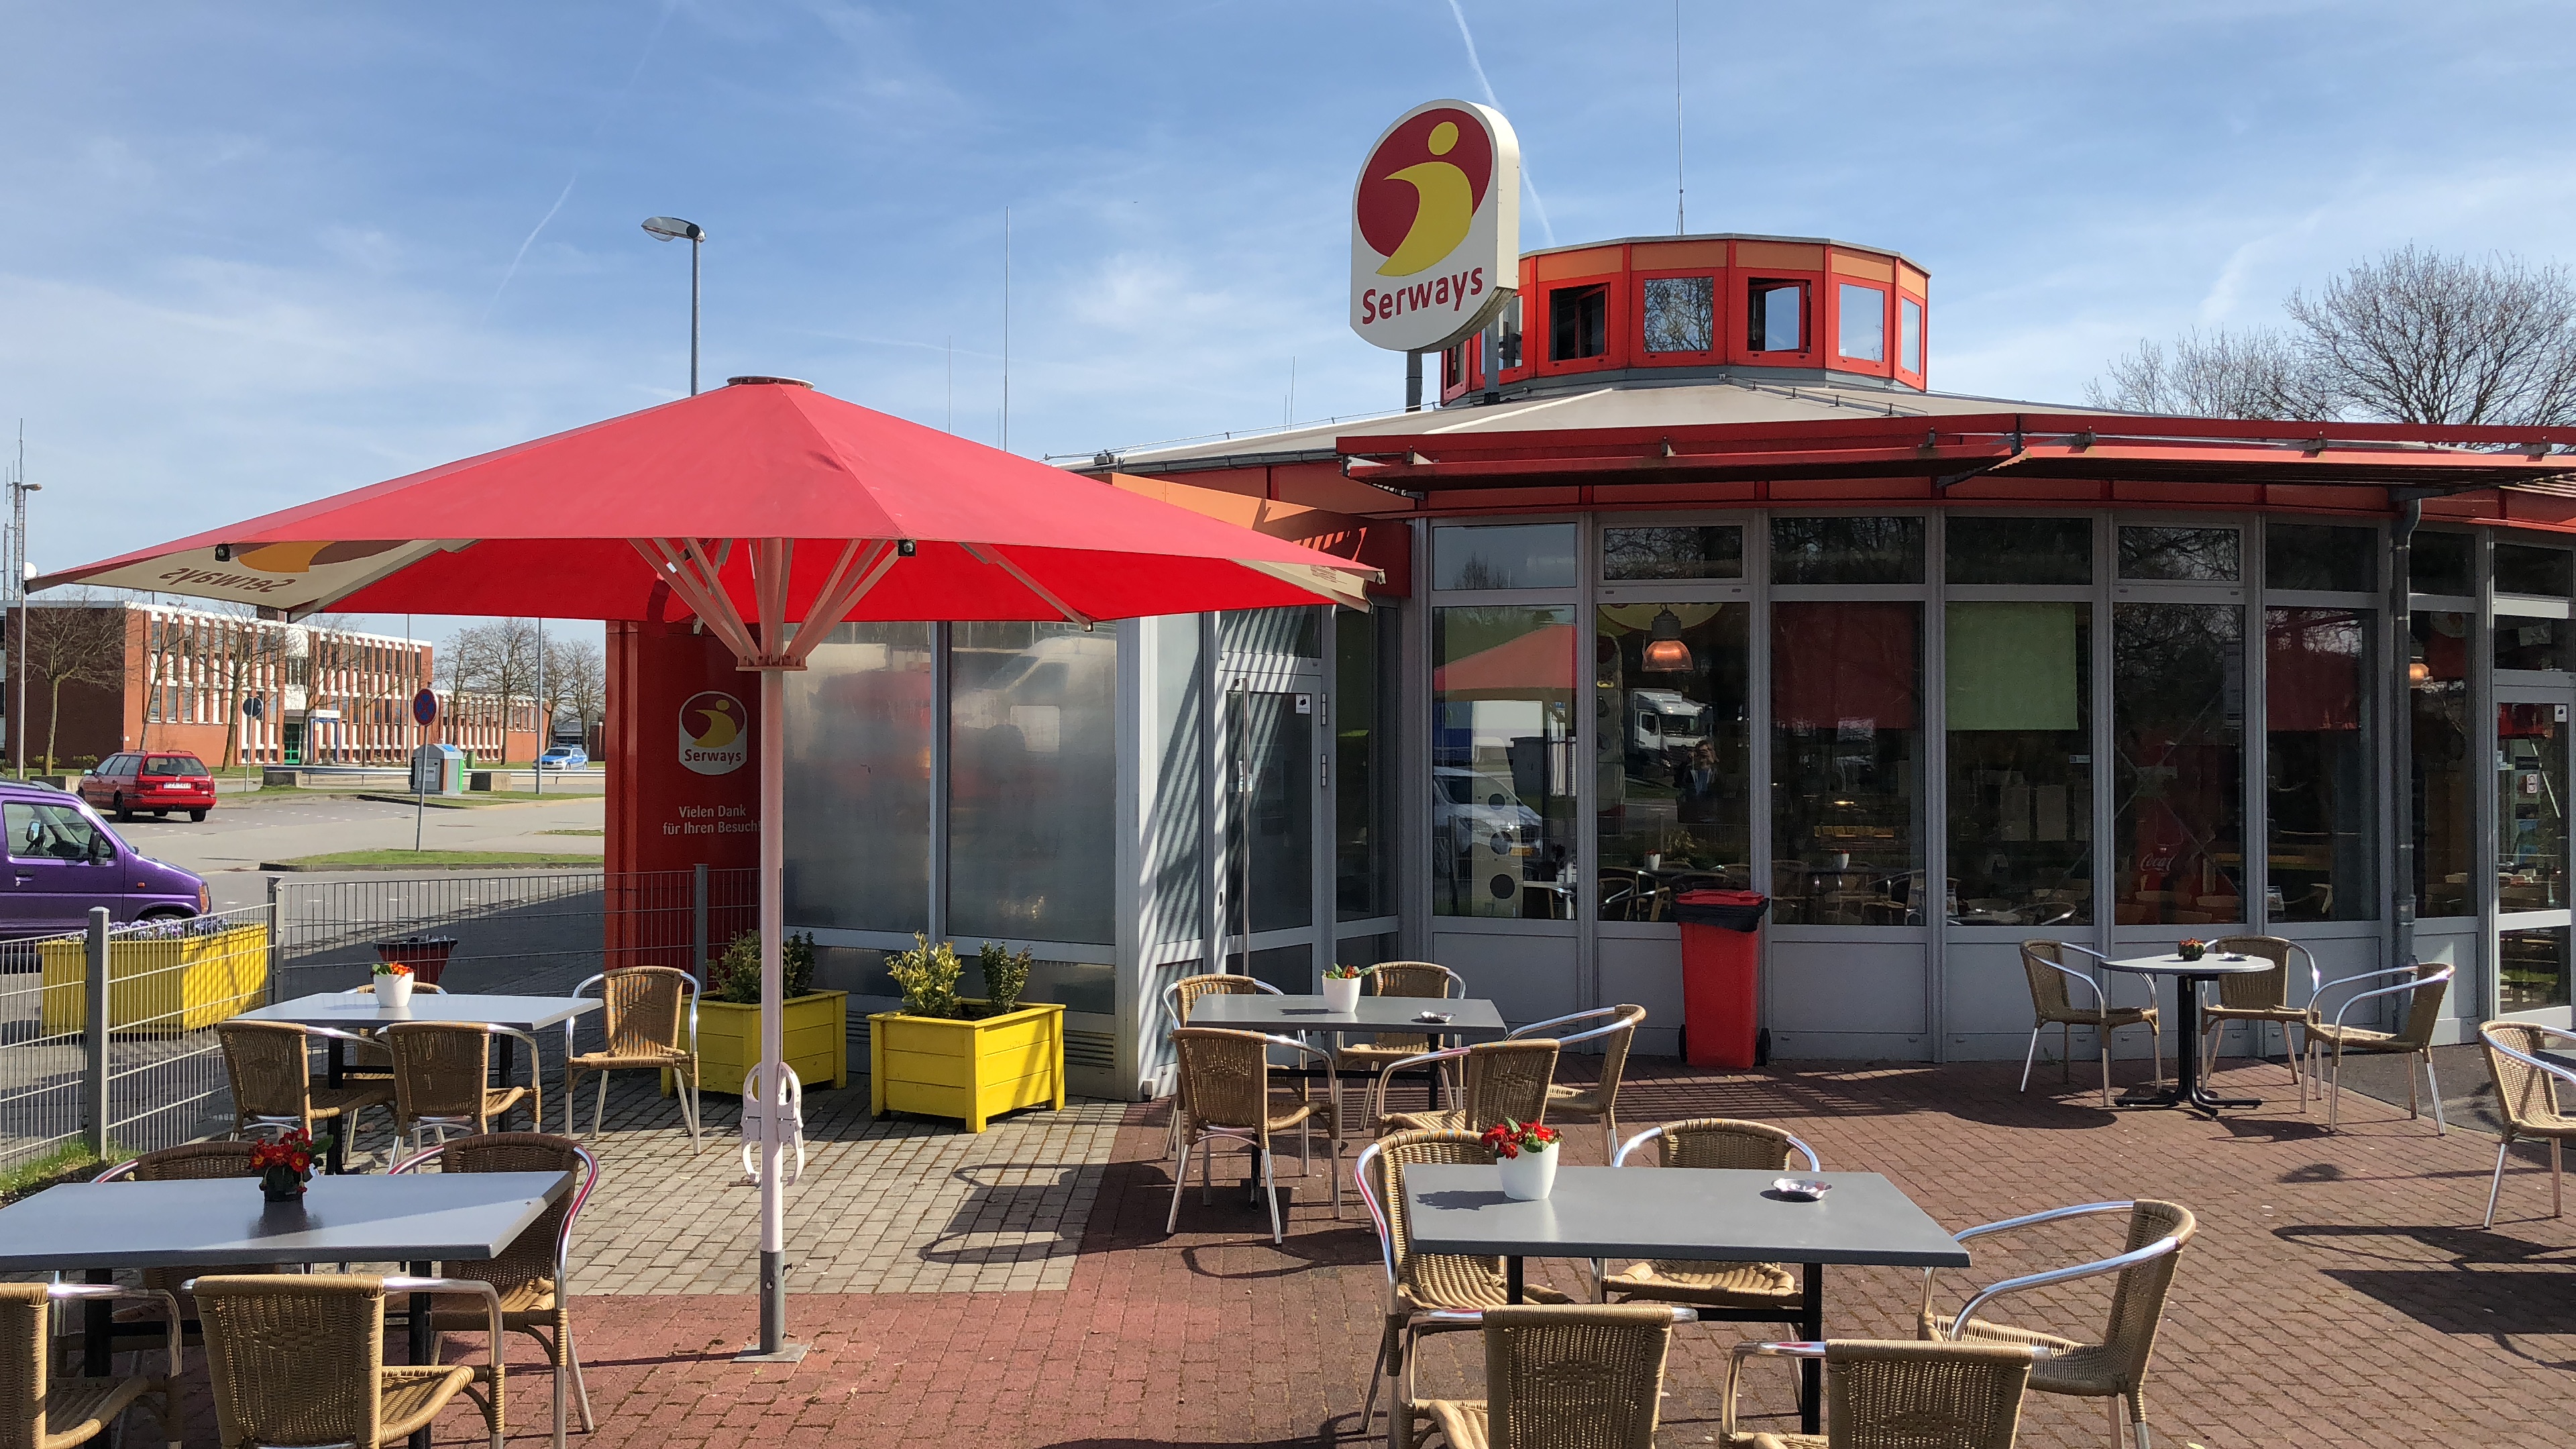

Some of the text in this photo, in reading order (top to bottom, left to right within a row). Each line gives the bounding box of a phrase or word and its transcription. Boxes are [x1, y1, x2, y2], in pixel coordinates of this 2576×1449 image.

[1362, 267, 1483, 325] Serways
[684, 749, 741, 765] Serways
[678, 804, 746, 818] Vielen Dank
[662, 822, 681, 835] für
[684, 821, 714, 834] Ihren
